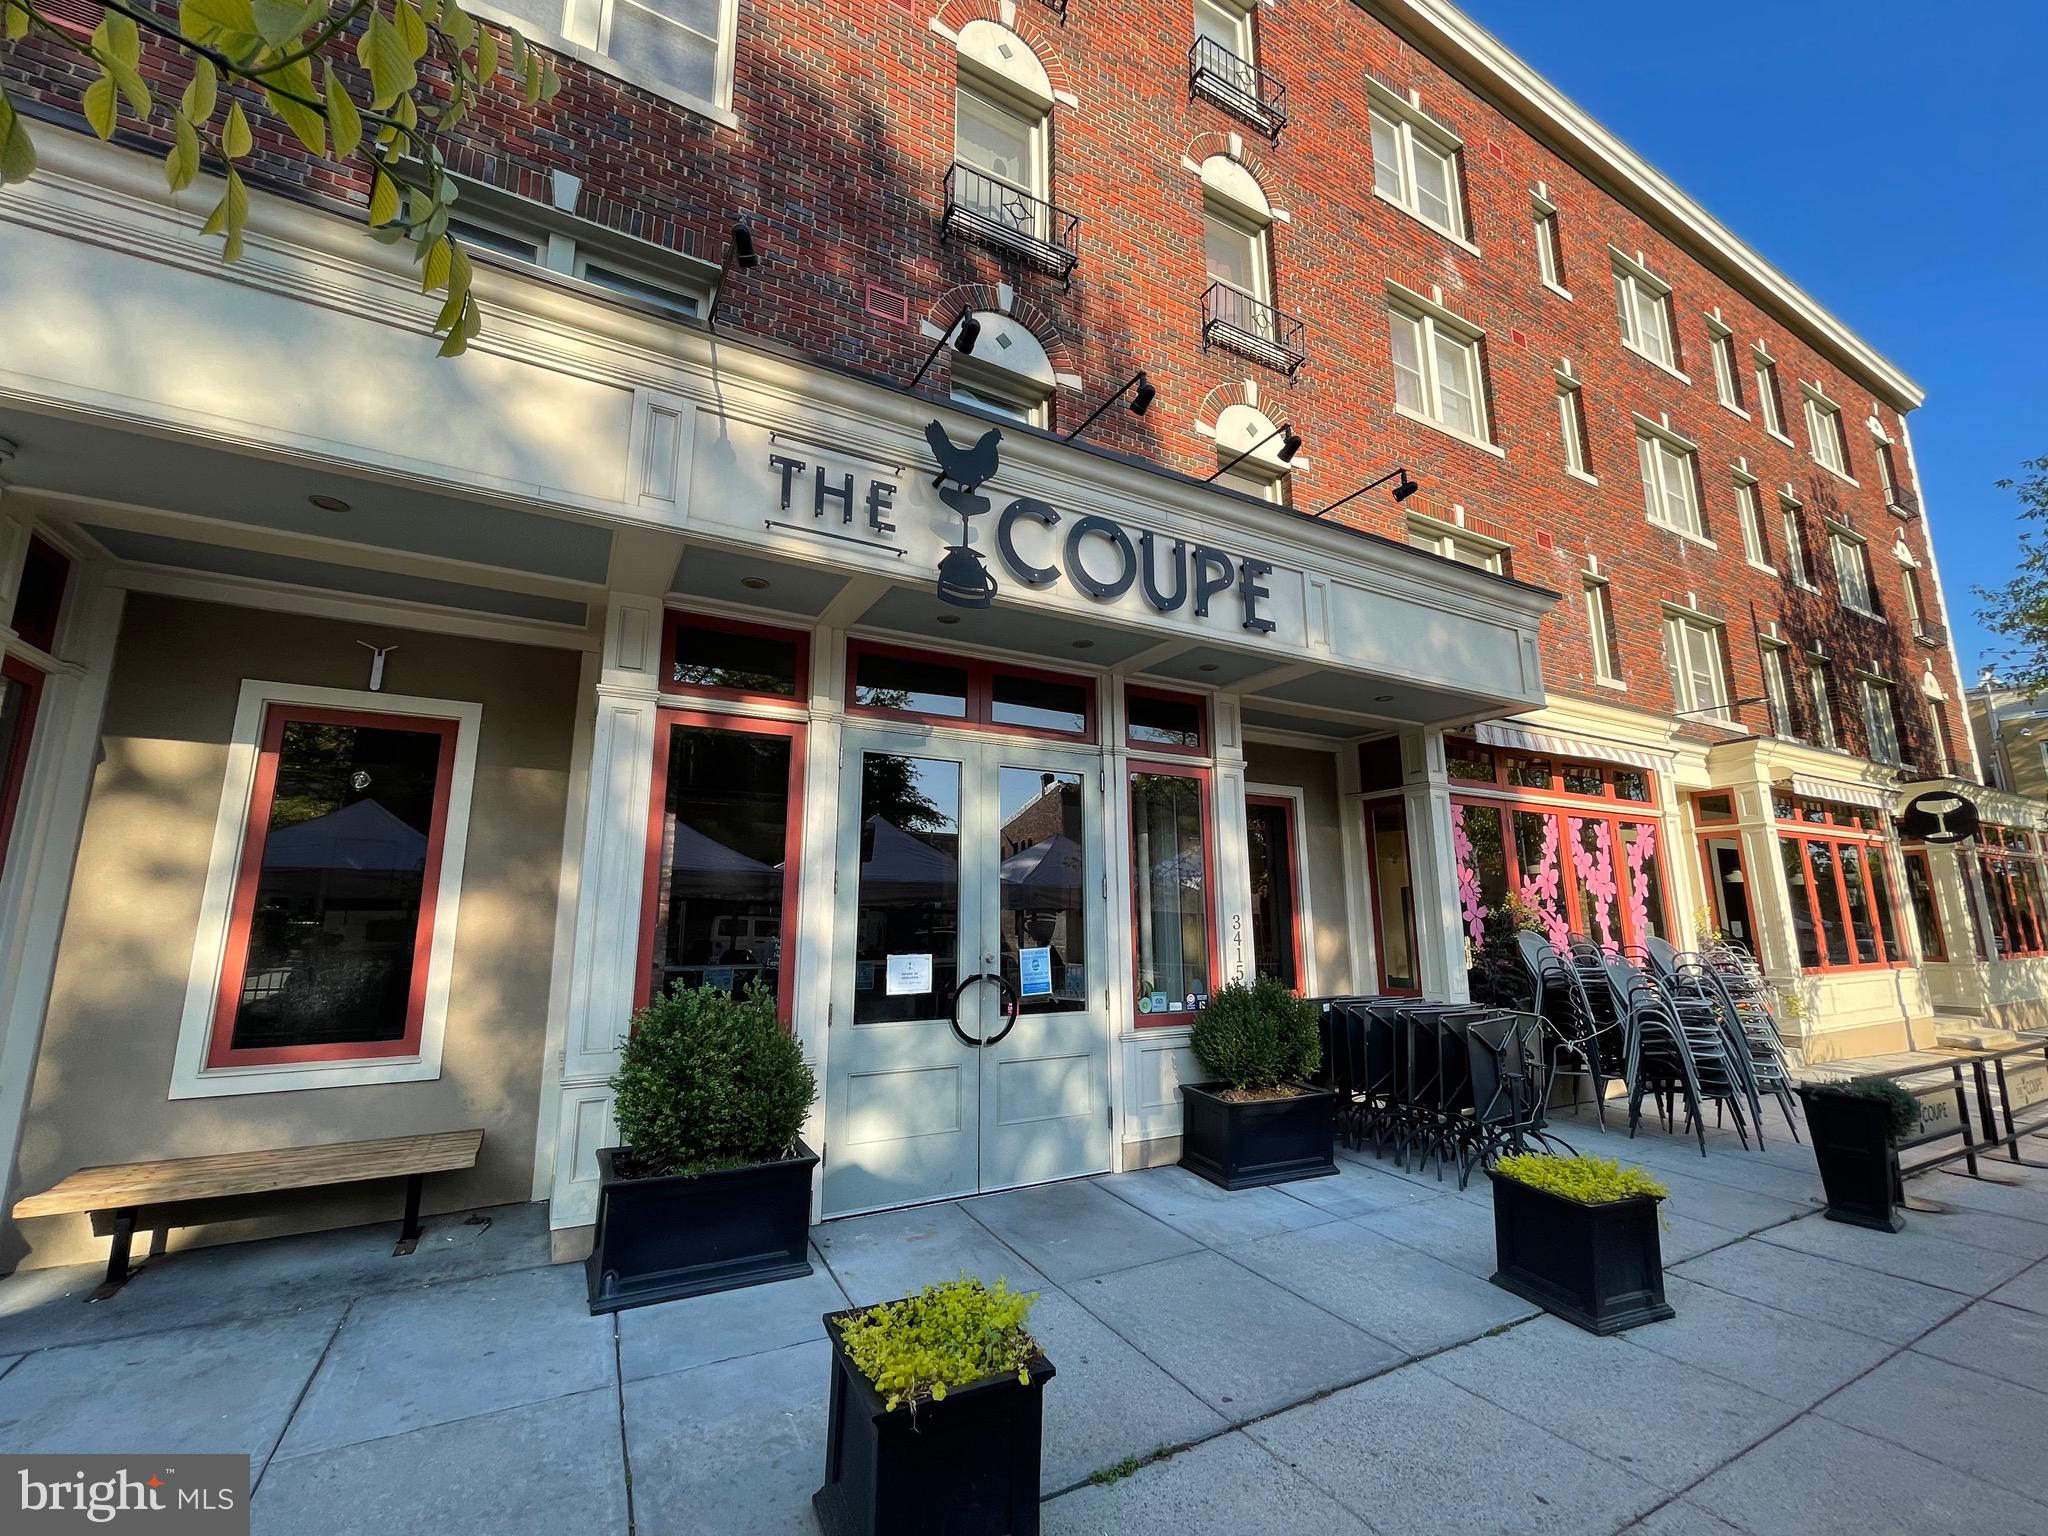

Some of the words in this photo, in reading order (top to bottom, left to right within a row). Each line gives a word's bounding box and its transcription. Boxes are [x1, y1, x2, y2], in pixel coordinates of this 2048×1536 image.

[769, 453, 897, 533] THE
[997, 497, 1276, 633] COUPE
[1231, 914, 1244, 981] 3415
[1922, 1101, 1948, 1122] COUPE
